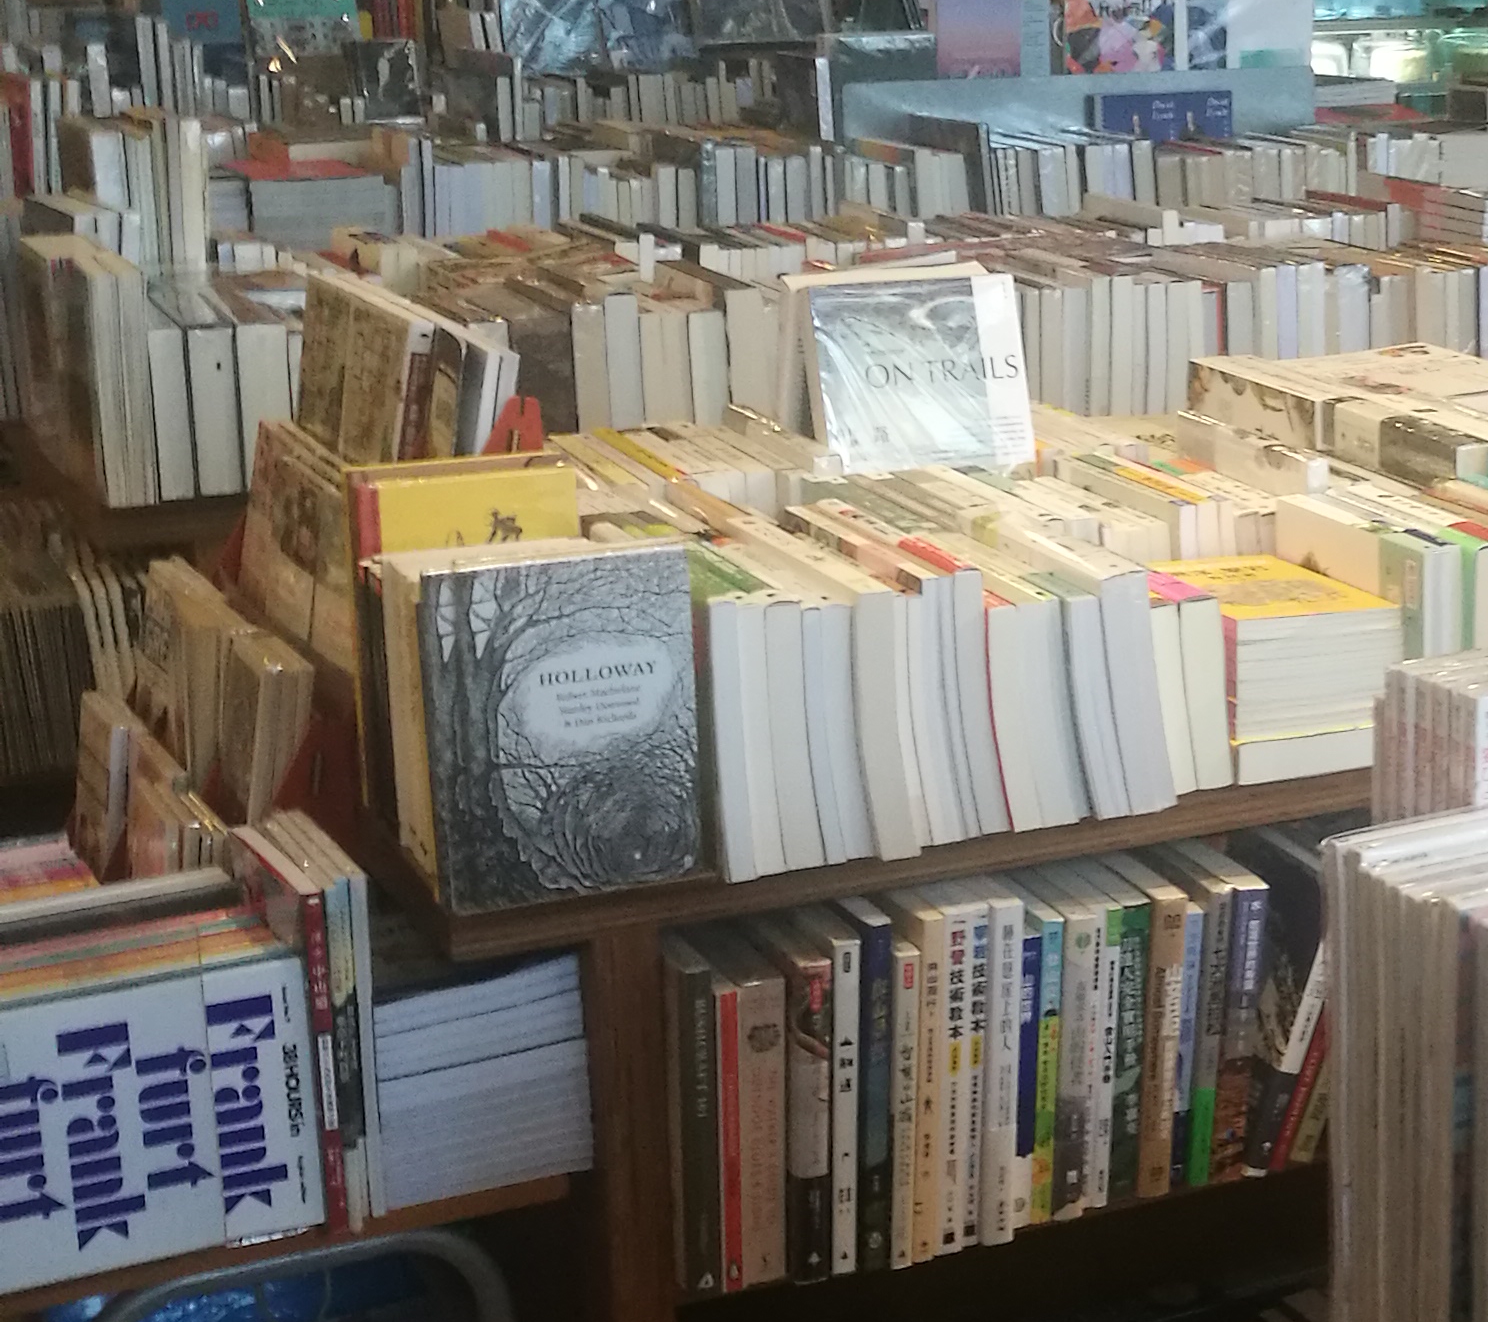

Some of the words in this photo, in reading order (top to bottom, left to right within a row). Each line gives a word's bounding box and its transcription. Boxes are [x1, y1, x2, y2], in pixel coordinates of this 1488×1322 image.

[865, 362, 914, 389] ON
[927, 354, 1020, 383] TRAILS
[540, 661, 656, 686] HOLLOWAY
